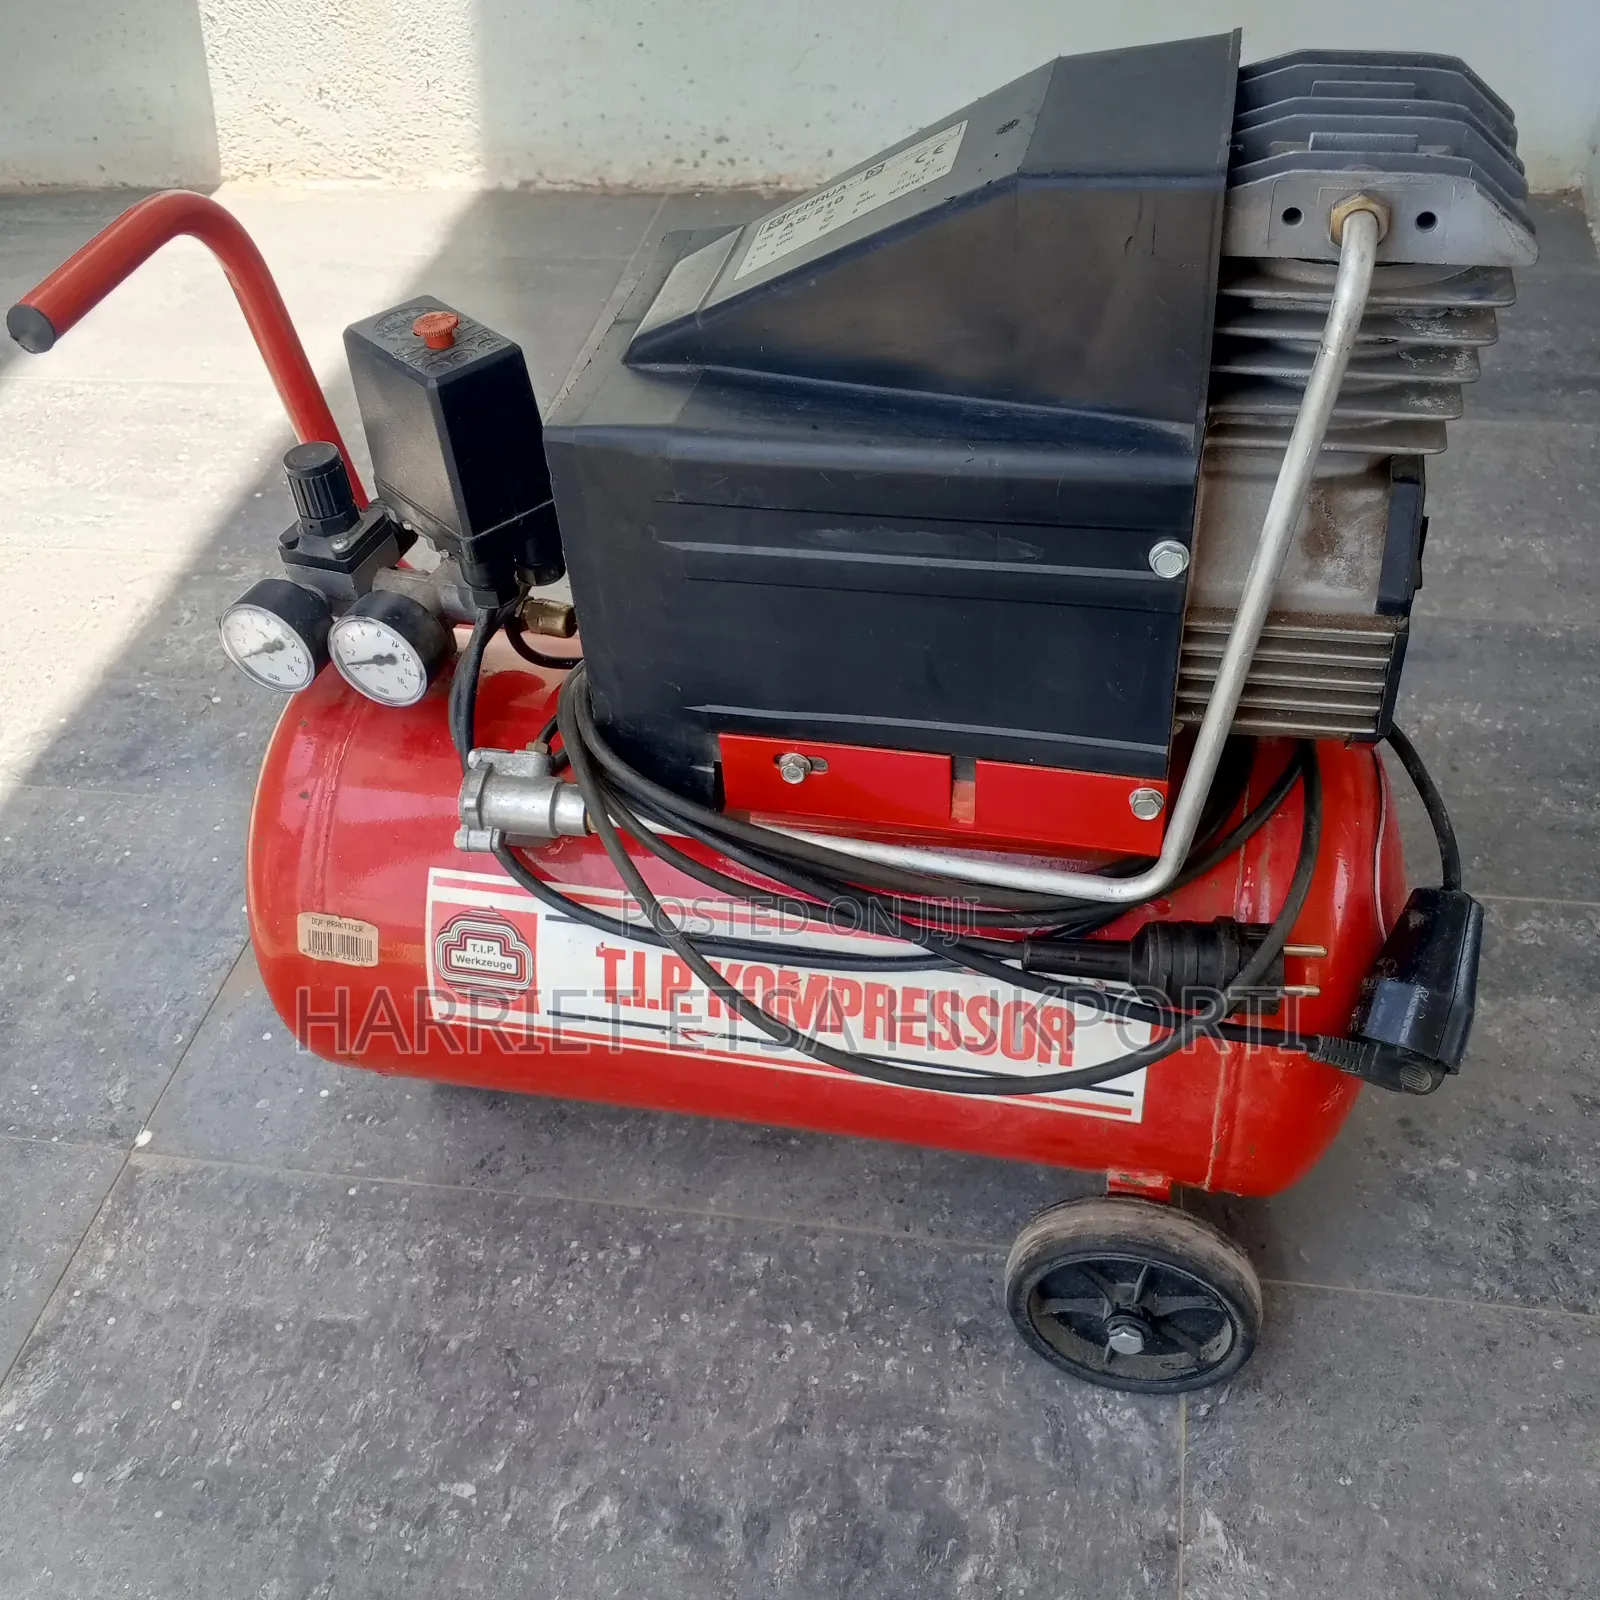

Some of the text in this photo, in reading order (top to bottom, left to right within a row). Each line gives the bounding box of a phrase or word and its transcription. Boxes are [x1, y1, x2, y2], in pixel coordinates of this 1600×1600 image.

[311, 917, 364, 933] DER PRAKTIKER
[471, 943, 496, 955] T.I.P.
[455, 954, 513, 971] Werkzeuge
